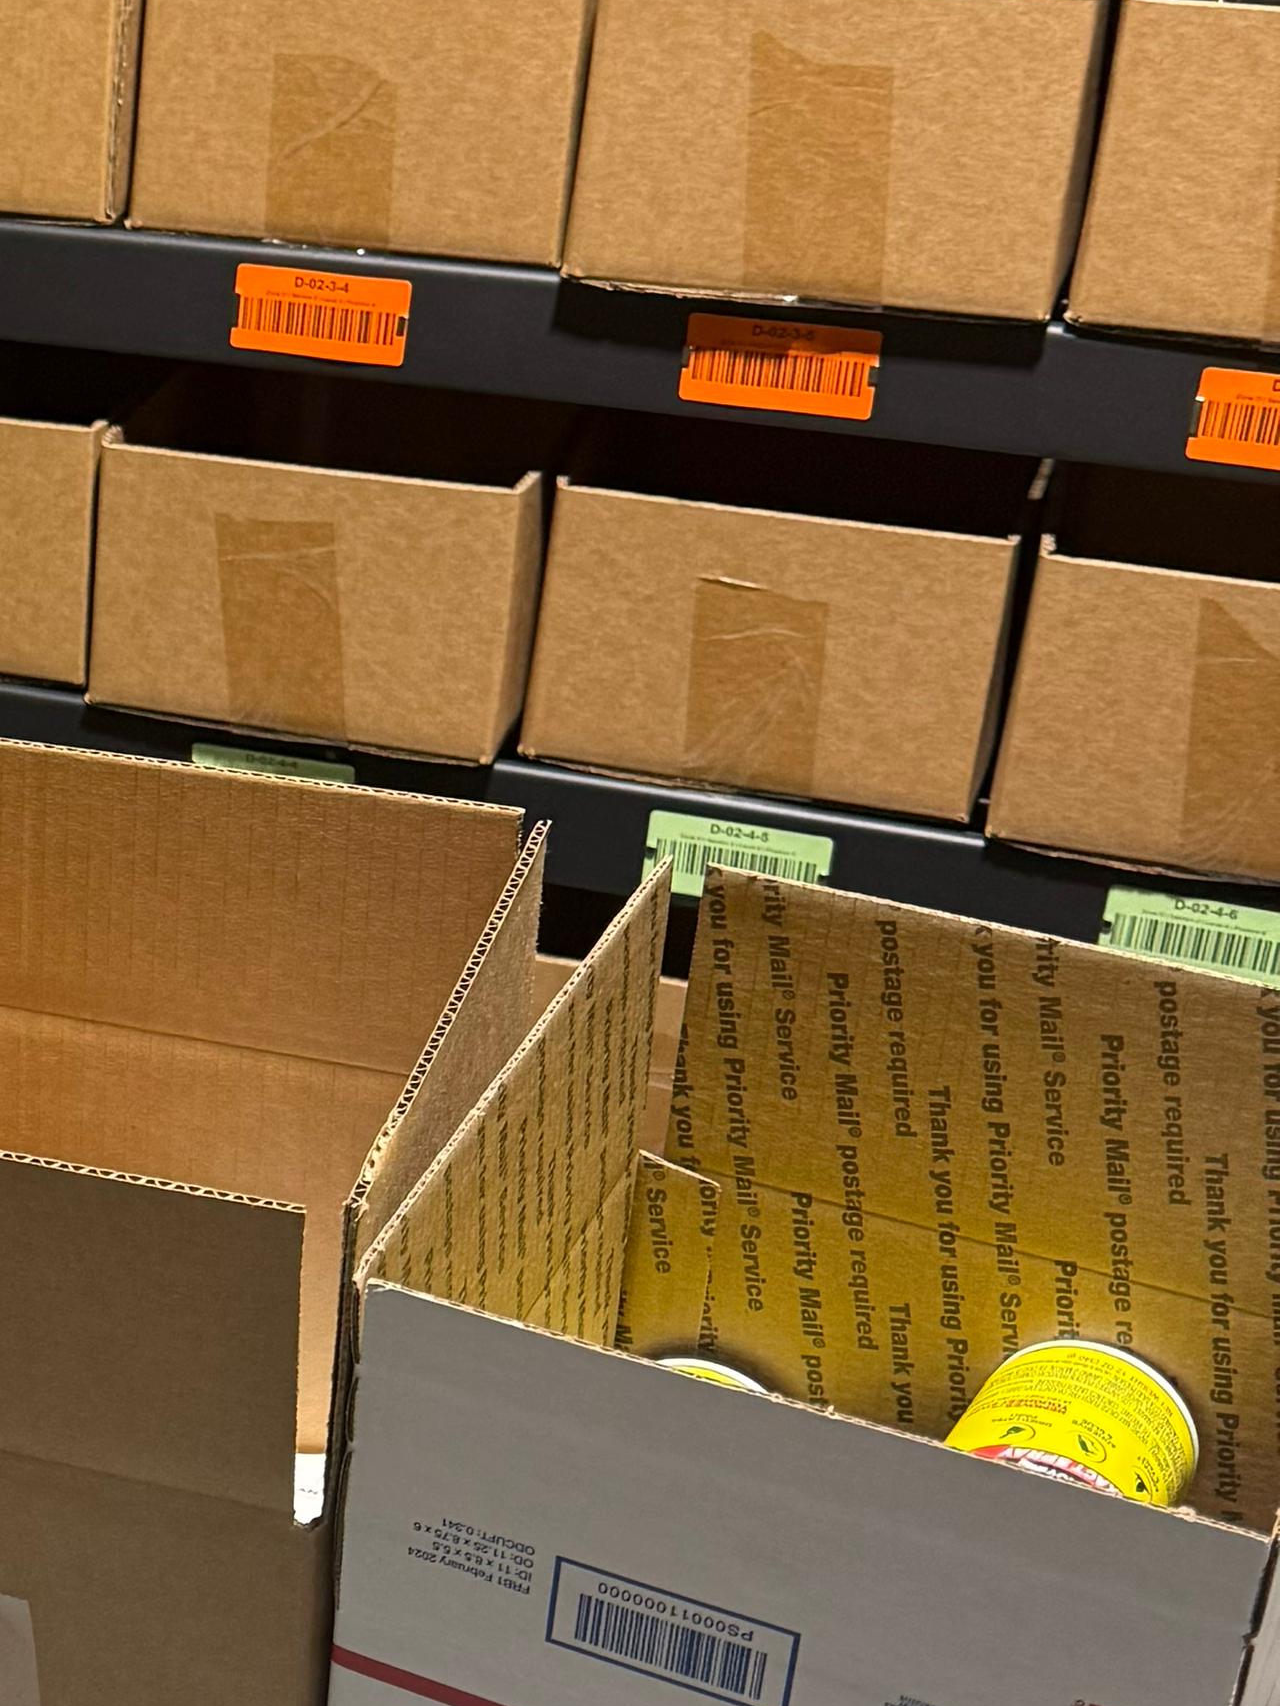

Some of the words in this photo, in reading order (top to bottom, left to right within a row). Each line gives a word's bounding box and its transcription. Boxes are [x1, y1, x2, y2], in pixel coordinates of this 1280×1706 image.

[294, 276, 349, 294] D-02-3-4
[708, 884, 729, 930] you
[1174, 898, 1239, 921] D-02-4-6
[712, 938, 735, 975] for
[874, 919, 905, 1023] postage
[971, 943, 997, 990] you
[715, 981, 742, 1050] using
[826, 972, 855, 1066] Priority
[978, 998, 1003, 1037] for
[1153, 980, 1183, 1088] postage
[774, 1007, 801, 1101] Service
[886, 1030, 918, 1139] required
[980, 1043, 1008, 1114] using
[1099, 1034, 1129, 1131] Priority
[723, 1057, 751, 1149] Priority
[927, 1085, 955, 1164] Thank
[1043, 1070, 1069, 1167] Service
[987, 1121, 1018, 1215] Priority
[1160, 1095, 1193, 1206] required
[835, 1144, 866, 1243] postage
[929, 1169, 955, 1215] you
[1204, 1153, 1233, 1232] Thank
[645, 1187, 674, 1274] Service
[790, 1191, 818, 1281] Priority
[938, 1222, 961, 1259] for
[1103, 1212, 1134, 1314] postage
[1202, 1239, 1228, 1287] you
[740, 1223, 768, 1313] Service
[843, 1249, 879, 1352] required
[940, 1263, 966, 1331] using
[1053, 1259, 1081, 1341] Priorit
[889, 1302, 916, 1375] Thank
[998, 1292, 1022, 1355] Servi
[1210, 1292, 1235, 1329] for
[800, 1354, 828, 1407] post
[891, 1378, 915, 1425] you
[946, 1337, 971, 1424] Priority
[1209, 1336, 1236, 1410] using
[1212, 1412, 1240, 1504] Priority
[407, 1546, 438, 1563] 2024
[434, 1529, 460, 1545] 8.75
[439, 1555, 493, 1583] February
[473, 1541, 507, 1560] 11.25
[477, 1530, 536, 1556] ODCUFT:
[498, 1563, 512, 1575] 11
[509, 1553, 534, 1569] OD:
[514, 1568, 532, 1582] ID:
[597, 1582, 754, 1642] PS00011000000
